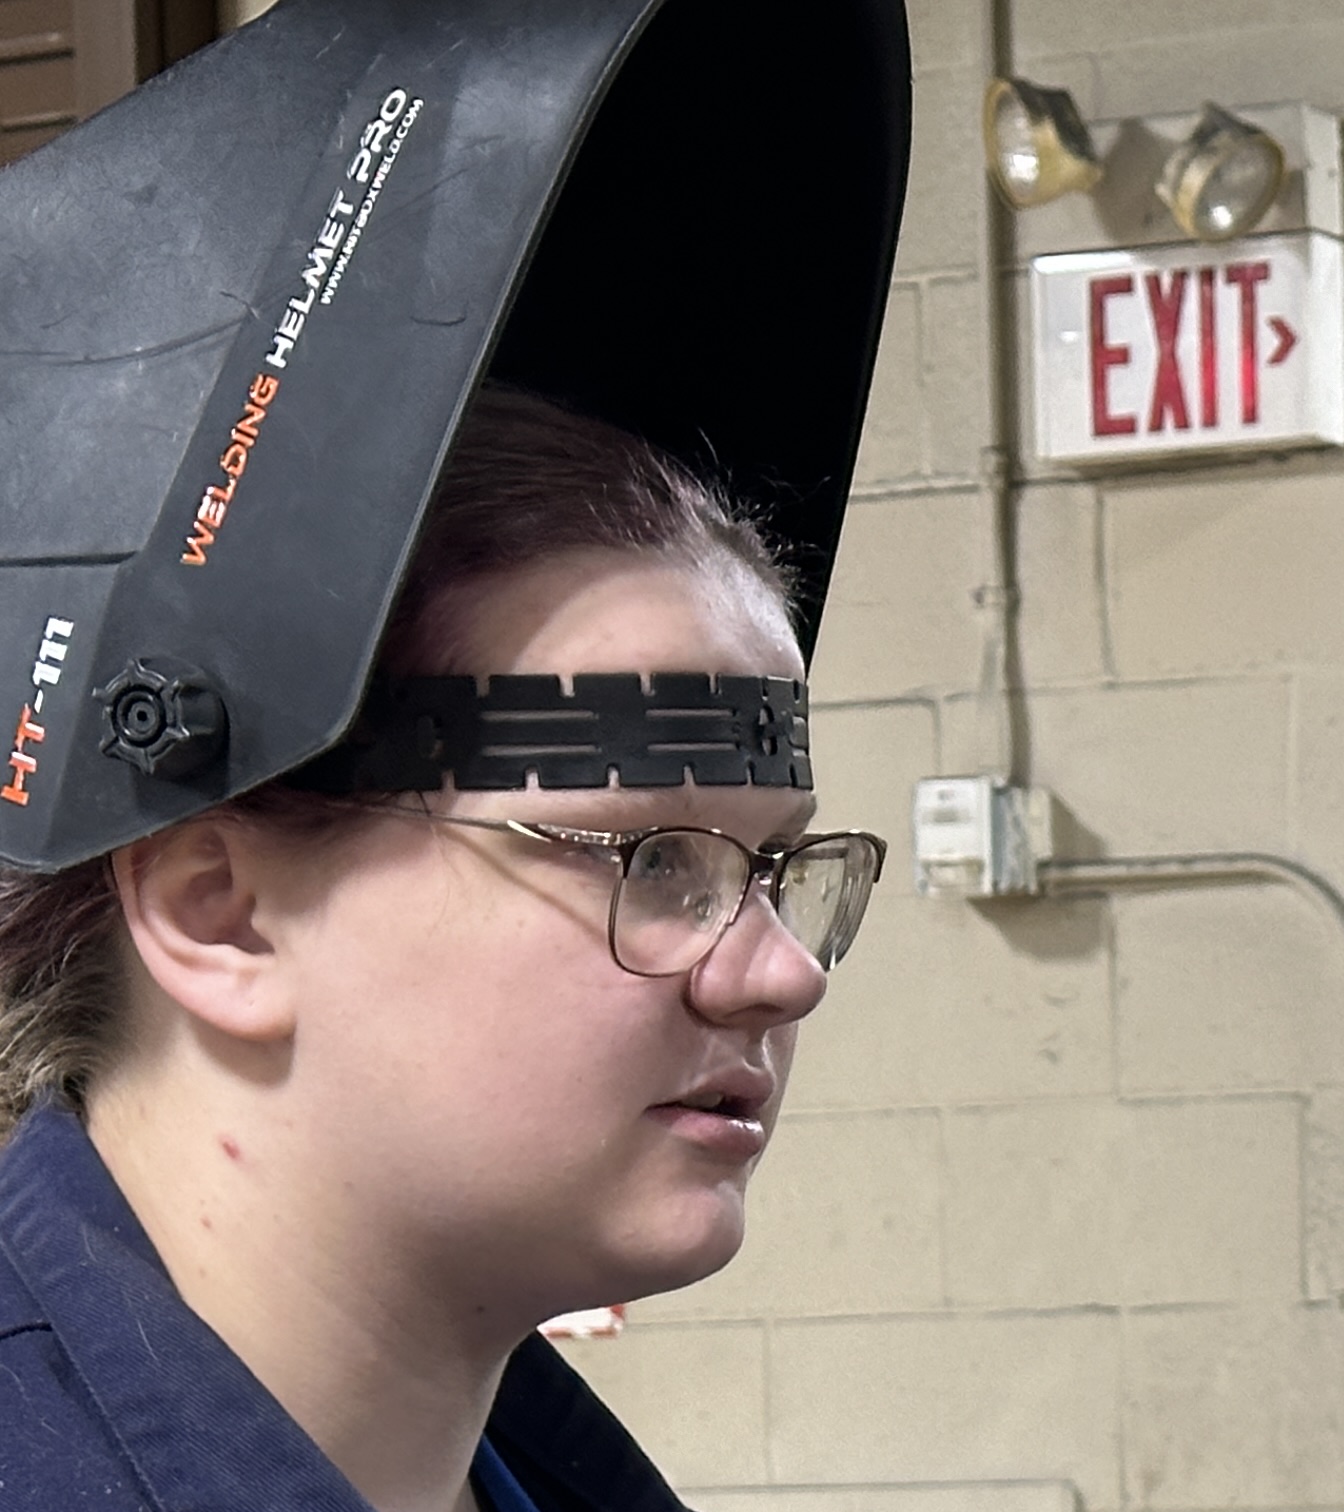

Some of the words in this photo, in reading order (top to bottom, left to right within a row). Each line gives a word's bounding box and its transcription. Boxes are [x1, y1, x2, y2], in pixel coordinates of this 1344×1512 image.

[180, 374, 280, 565] WELDING
[265, 188, 354, 368] HELMET
[346, 88, 407, 182] PRO
[1090, 262, 1270, 437] EXIT
[0, 617, 74, 806] HT-111
